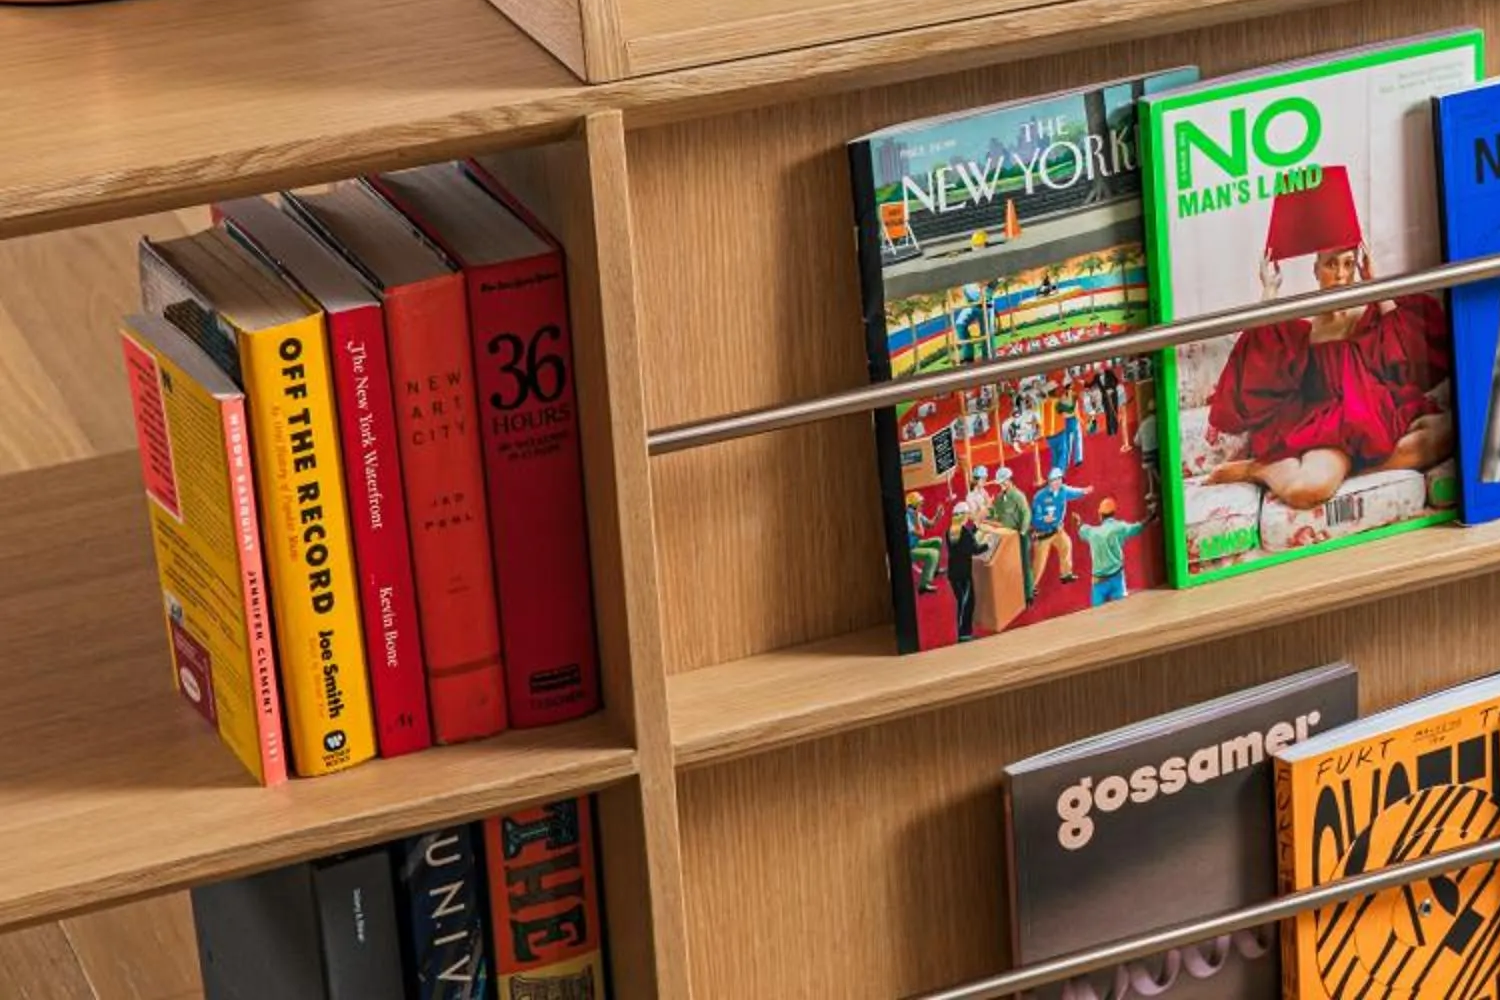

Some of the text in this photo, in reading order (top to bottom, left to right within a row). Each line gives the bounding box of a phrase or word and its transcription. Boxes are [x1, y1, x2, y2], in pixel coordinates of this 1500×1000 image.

[1020, 115, 1068, 141] THE
[1174, 96, 1322, 191] NO
[901, 154, 1005, 221] NEW
[1012, 124, 1142, 197] YORK
[1177, 163, 1323, 219] MAN'S LAND
[278, 336, 307, 399] OFF
[407, 371, 462, 394] NEW
[484, 324, 567, 411] 36
[347, 339, 383, 530] The New York Waterfront
[412, 396, 462, 419] ART
[412, 421, 465, 446] CITY
[491, 405, 572, 436] HOURS
[286, 407, 317, 473] THE
[297, 480, 335, 615] RECORD
[318, 630, 335, 661] Joe
[378, 586, 399, 668] Kevin Bone
[256, 647, 273, 714] CLEMENT
[322, 662, 345, 719] Smith
[1056, 709, 1321, 851] gossamer
[1316, 737, 1397, 785] FUKT
[502, 799, 590, 963] THE
